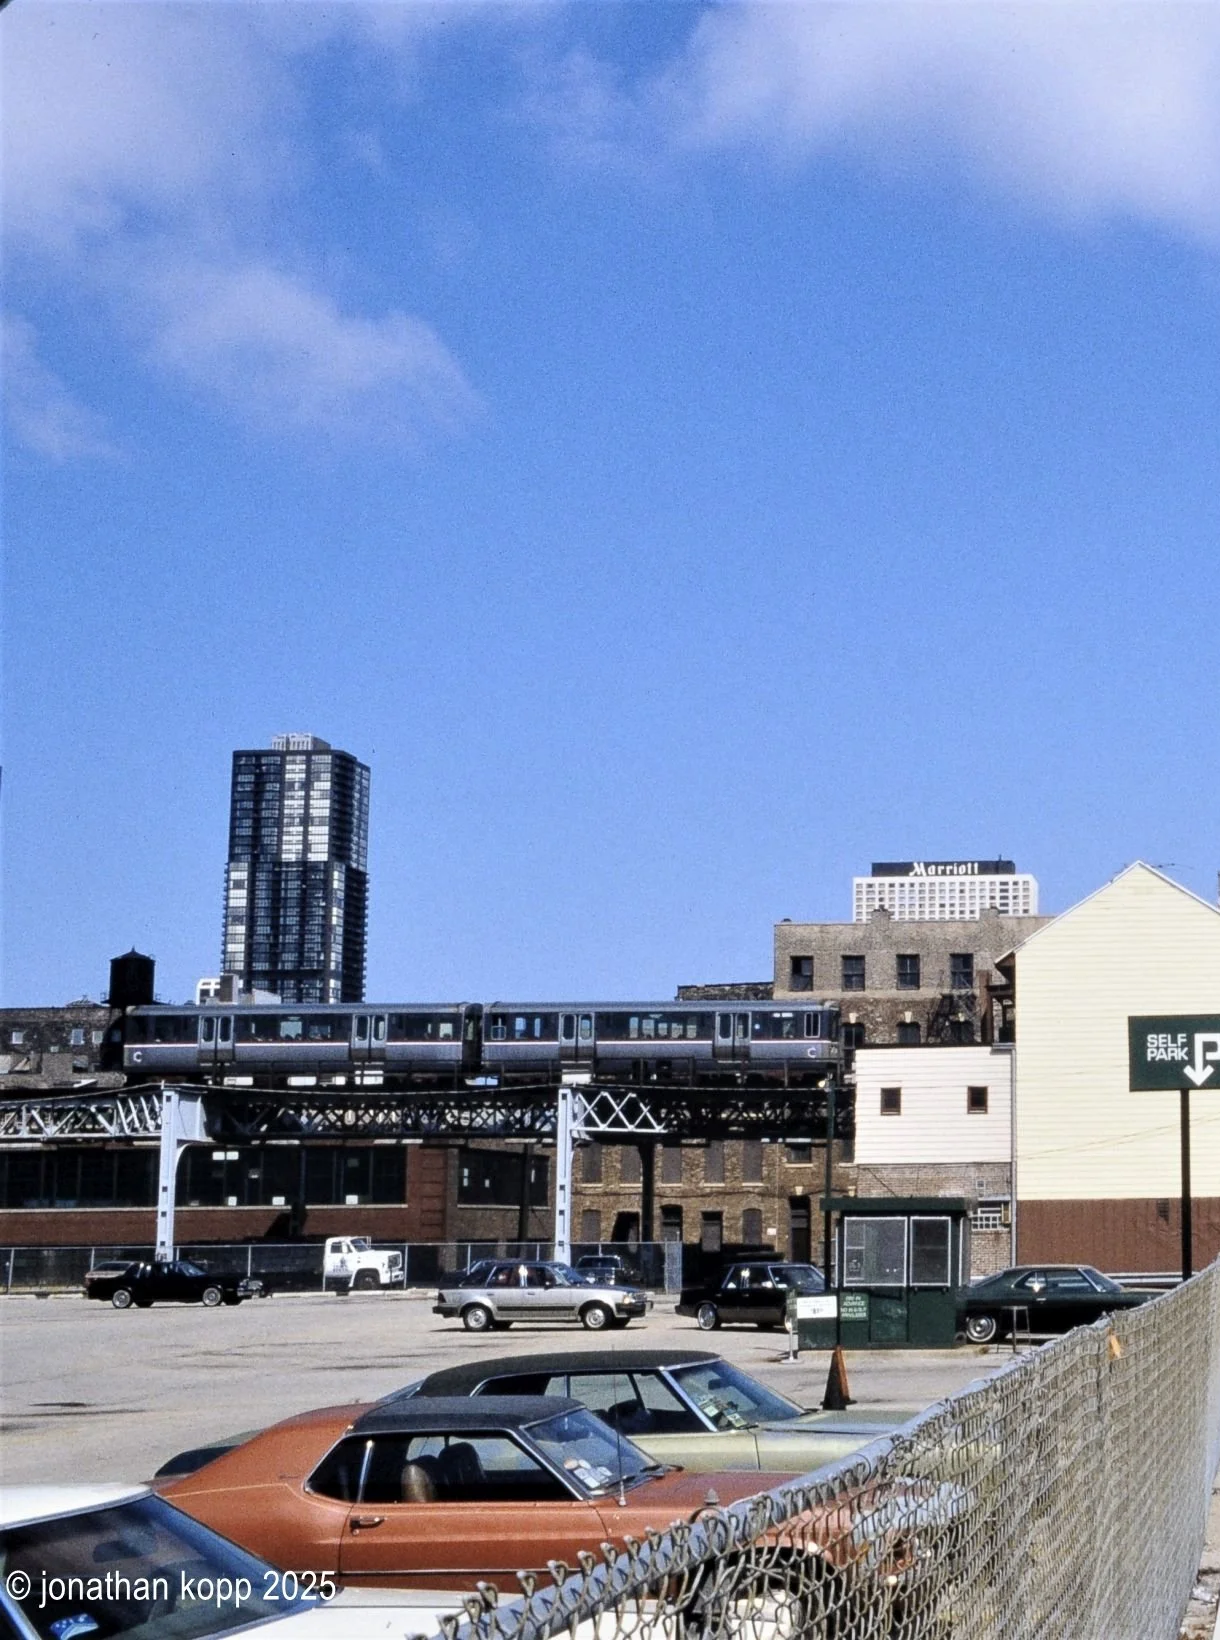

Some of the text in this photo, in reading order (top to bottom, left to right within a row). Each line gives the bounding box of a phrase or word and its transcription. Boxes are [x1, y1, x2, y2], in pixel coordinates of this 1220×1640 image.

[909, 862, 979, 876] Marriott
[1147, 1033, 1187, 1047] SELF
[133, 1051, 142, 1063] C
[807, 1047, 816, 1059] C
[1147, 1047, 1188, 1061] PARK
